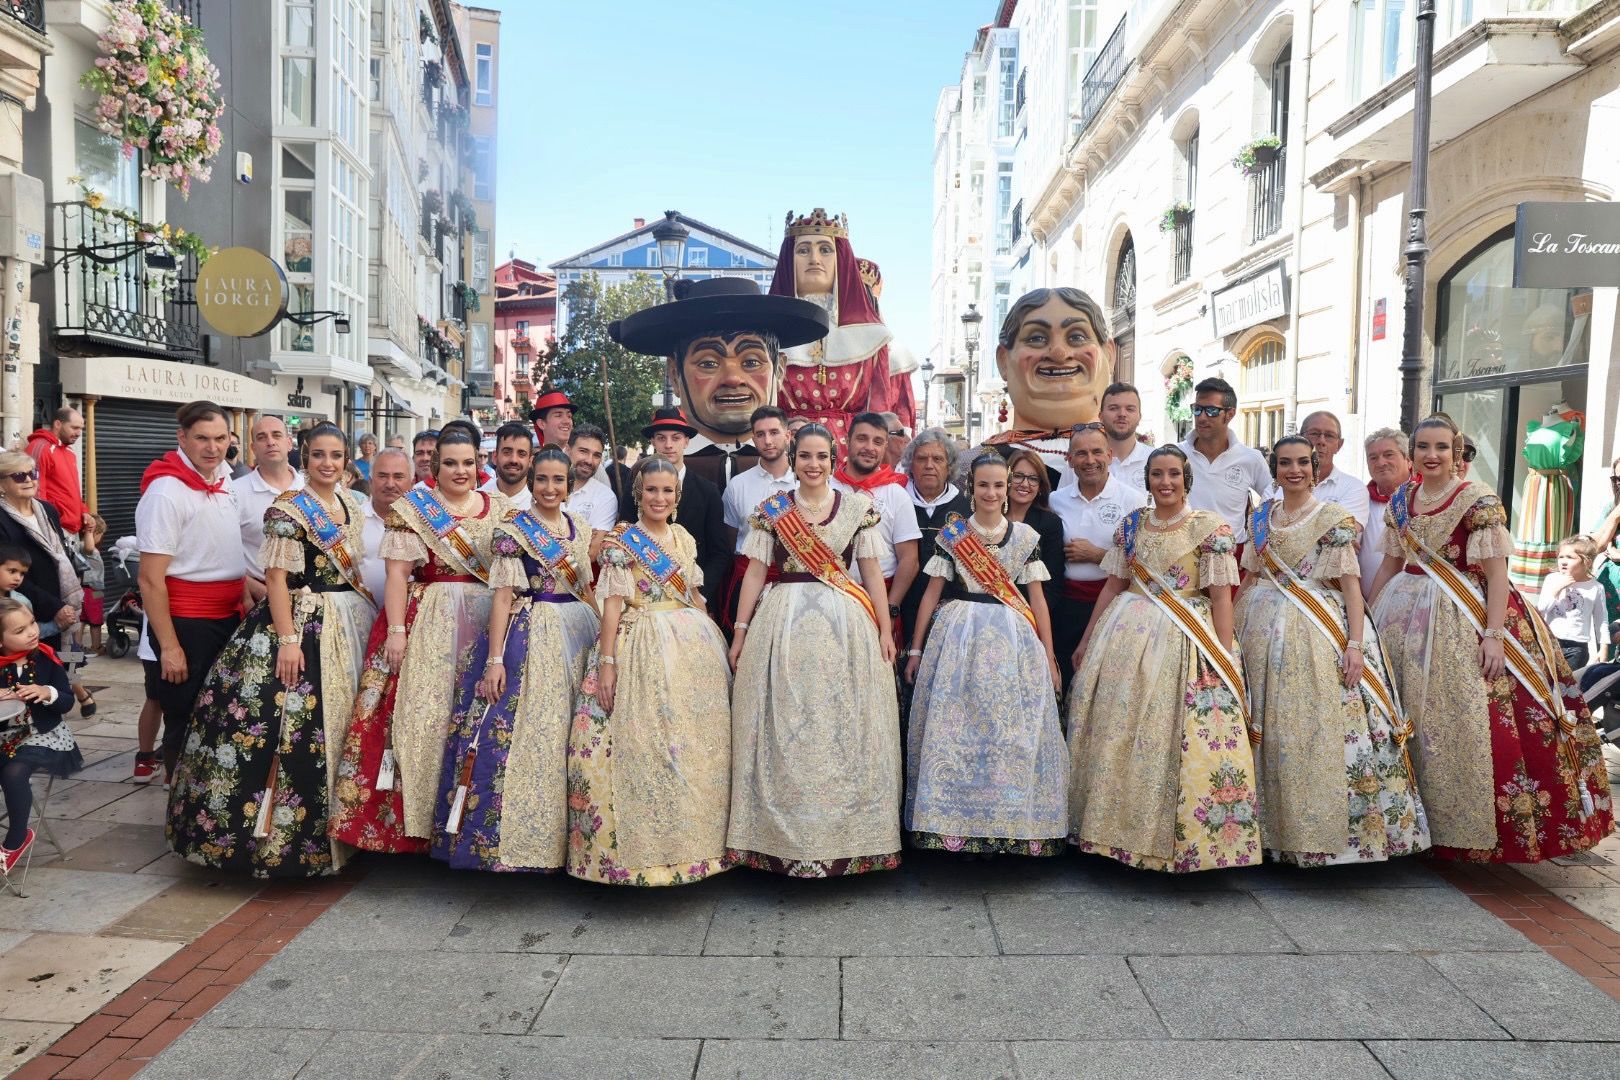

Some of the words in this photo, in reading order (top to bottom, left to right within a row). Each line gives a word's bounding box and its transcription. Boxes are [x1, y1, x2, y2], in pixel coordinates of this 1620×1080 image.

[1527, 232, 1559, 253] La
[204, 278, 273, 290] LAURA
[204, 292, 273, 306] JORGE
[1218, 274, 1281, 328] marmolista
[1463, 358, 1506, 377] Toscana
[127, 365, 186, 387] LAURA
[195, 374, 239, 393] JORGE
[287, 389, 312, 409] sakura
